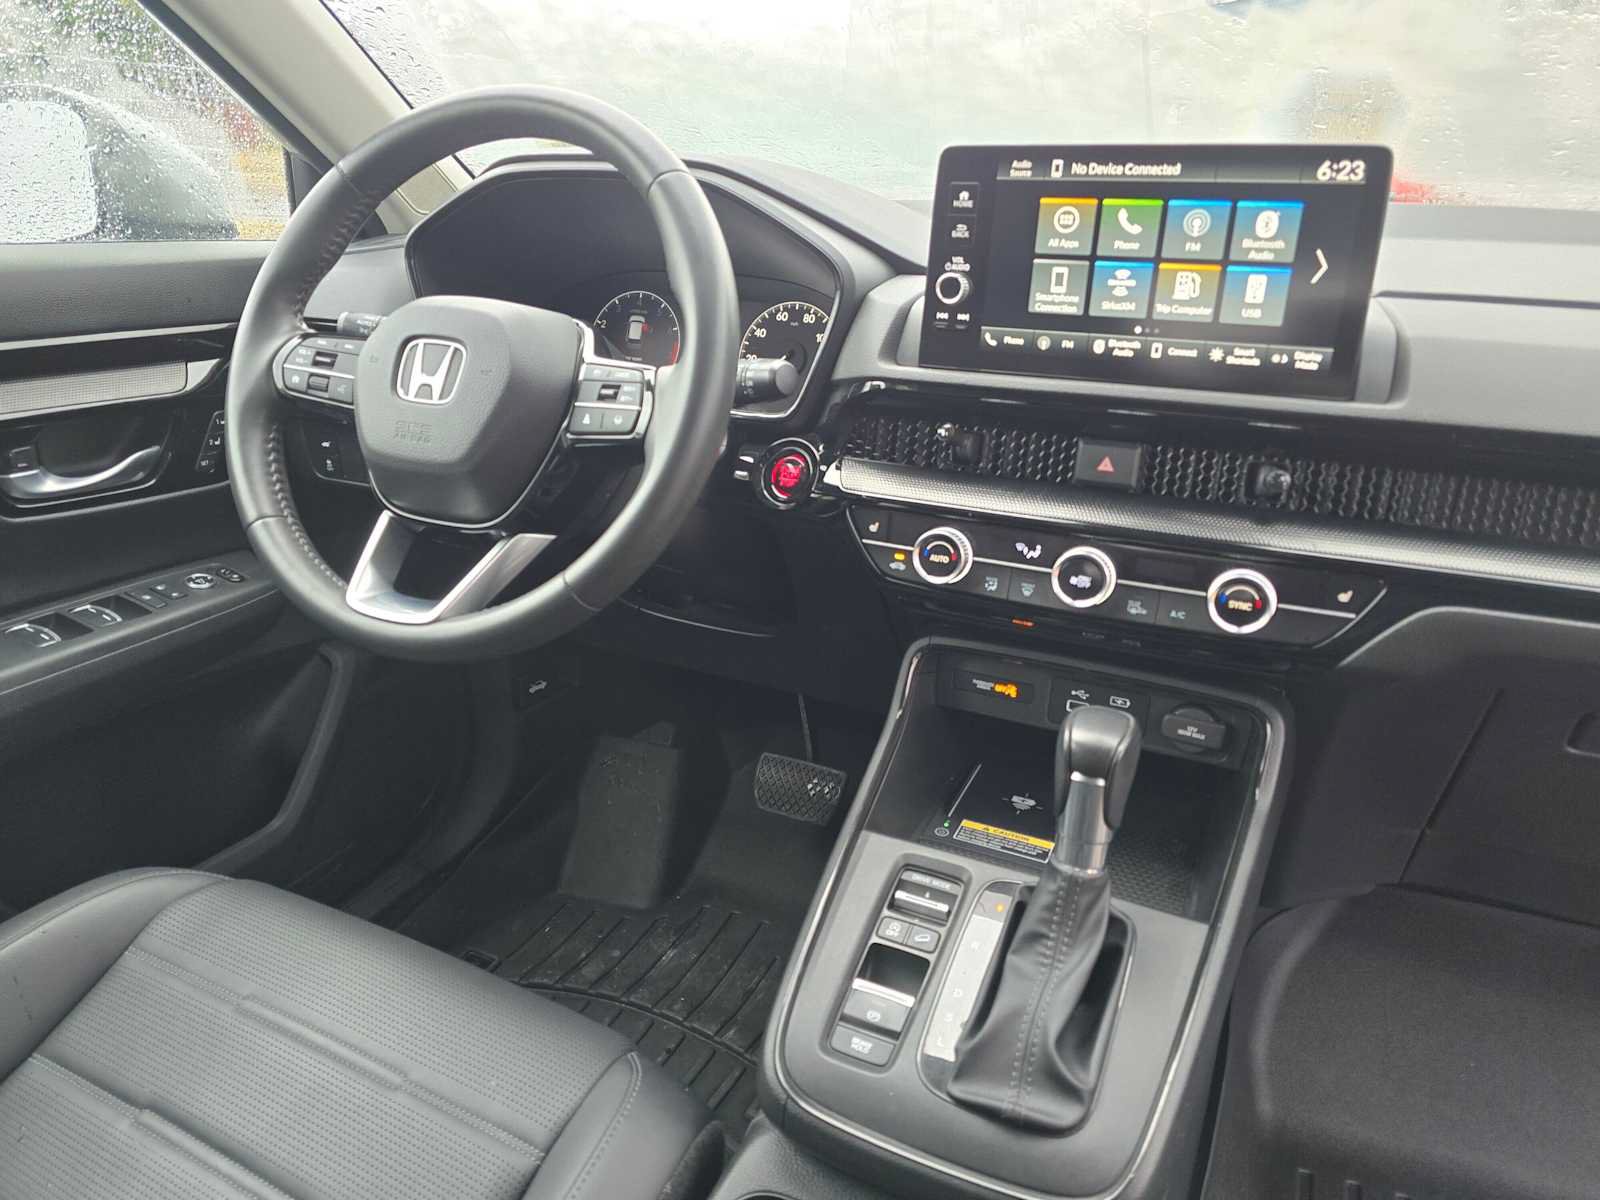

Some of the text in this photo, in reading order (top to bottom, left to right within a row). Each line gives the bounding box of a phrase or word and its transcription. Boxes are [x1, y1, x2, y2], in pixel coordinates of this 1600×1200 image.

[1012, 160, 1032, 168] Audio
[1071, 162, 1182, 176] No Device Connected
[1316, 160, 1366, 181] 6:23
[953, 200, 973, 208] HOME
[952, 230, 970, 238] BACK
[1048, 239, 1079, 249] All Apps
[1114, 241, 1140, 250] Phone
[1185, 243, 1201, 252] FM
[1242, 238, 1285, 249] Bluetooth
[1248, 250, 1275, 260] Audio
[1035, 293, 1080, 303] Smartphone
[1035, 303, 1077, 313] Connection
[1155, 304, 1212, 315] Trip Computer
[1241, 308, 1262, 318] USB
[776, 312, 788, 321] 60
[803, 314, 816, 323] 80
[601, 320, 607, 328] 2
[754, 328, 767, 338] 40
[815, 334, 825, 343] 10
[1004, 335, 1024, 346] Phone
[1061, 340, 1074, 349] FM
[929, 554, 950, 564] AUTO
[1228, 599, 1253, 612] SYNC
[1170, 610, 1186, 620] A/C
